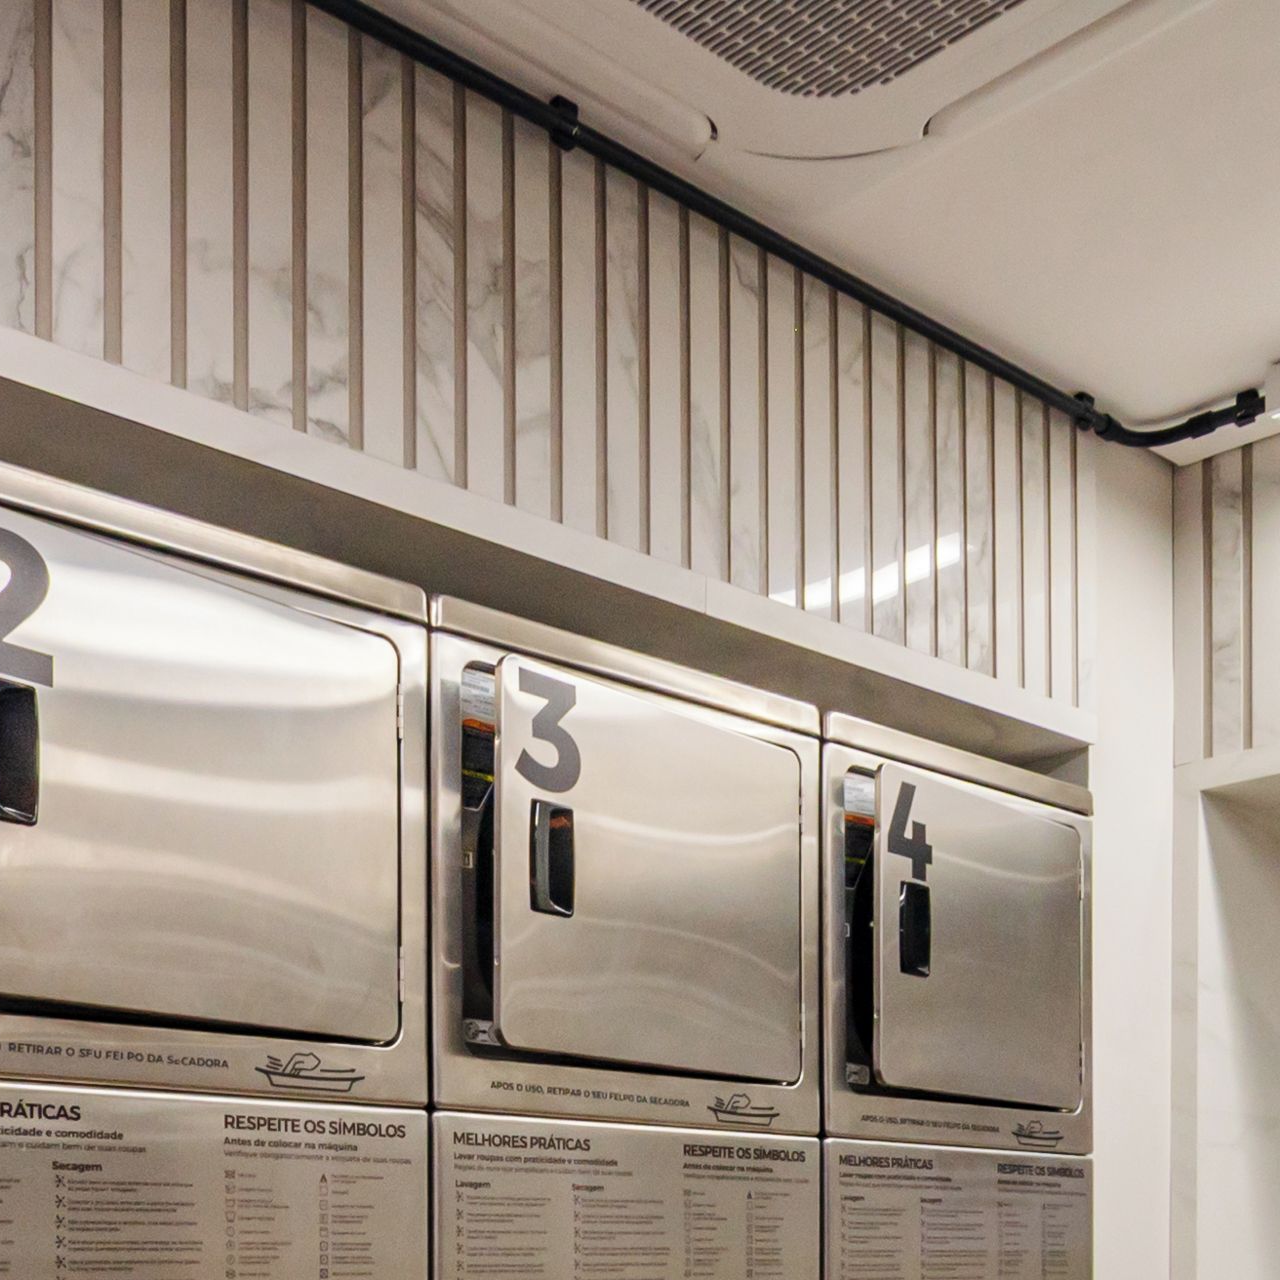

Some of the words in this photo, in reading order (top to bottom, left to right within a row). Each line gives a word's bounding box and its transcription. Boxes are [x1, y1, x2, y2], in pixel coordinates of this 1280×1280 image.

[515, 667, 581, 793] 3
[888, 782, 932, 882] 4
[9, 1042, 61, 1056] RETIRAR
[66, 1047, 74, 1056] O
[145, 1051, 165, 1064] DA
[55, 1129, 123, 1140] comodidade
[224, 1115, 300, 1133] RESPEITE
[305, 1120, 325, 1134] OS
[329, 1118, 406, 1138] SÍMBOLOS
[224, 1137, 252, 1148] Antes
[254, 1138, 266, 1147] de
[268, 1140, 301, 1149] colocar
[453, 1131, 527, 1148] MELHORES
[530, 1134, 590, 1151] PRÁTICAS
[684, 1144, 734, 1158] RESPEITE
[736, 1148, 751, 1159] OS
[753, 1146, 806, 1162] SÍMBOLOS
[52, 1161, 102, 1173] Secagem
